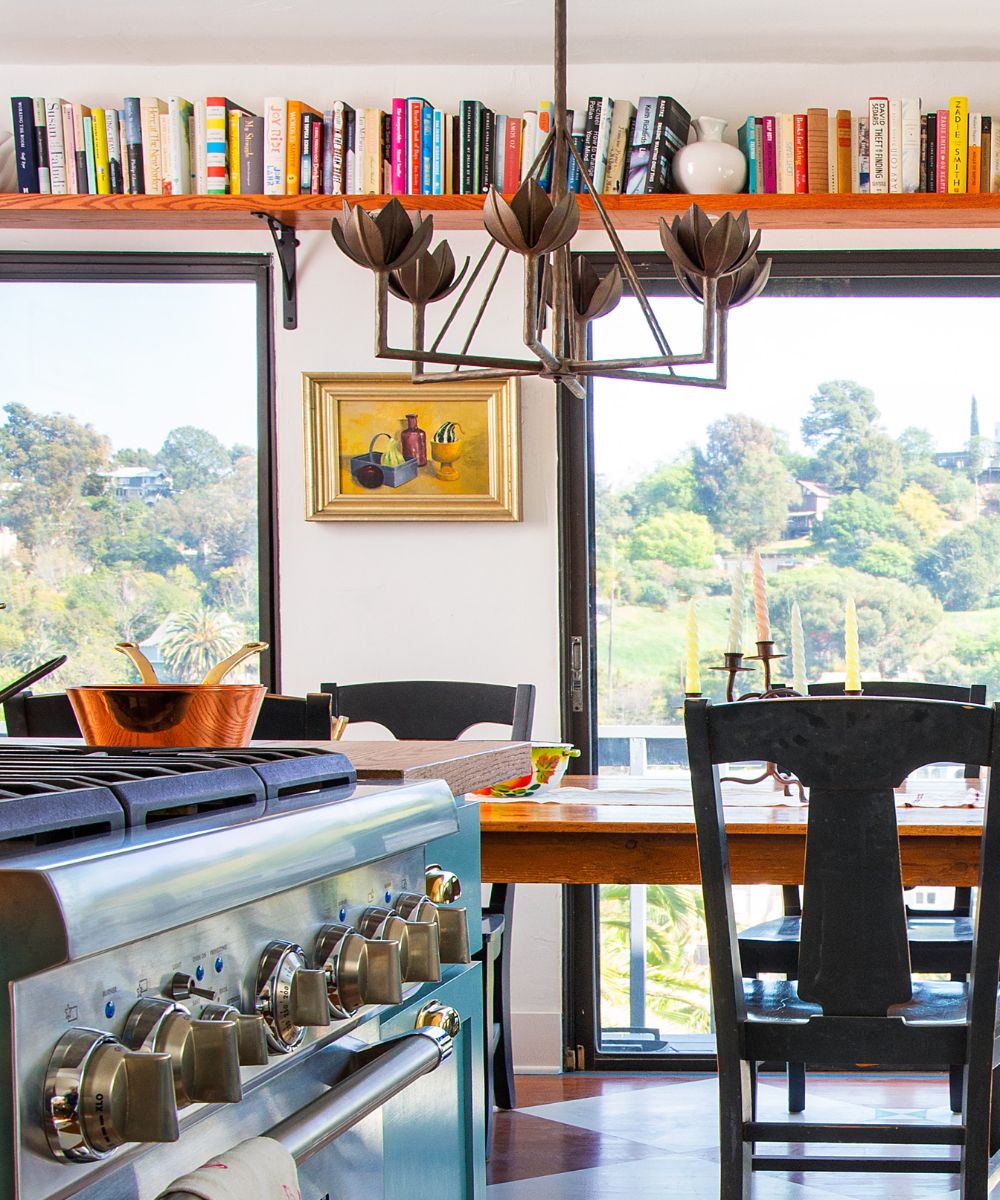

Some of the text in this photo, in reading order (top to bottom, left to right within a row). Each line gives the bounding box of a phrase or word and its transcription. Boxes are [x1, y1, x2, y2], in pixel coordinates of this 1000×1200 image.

[47, 103, 60, 138] Susan
[270, 105, 282, 125] JOY
[594, 101, 602, 126] Michael
[640, 104, 652, 144] Keith Richards
[151, 135, 160, 148] The
[584, 100, 596, 161] Pollan Your Mind
[875, 128, 883, 148] THEFT
[510, 139, 516, 149] OZ
[592, 145, 598, 153] to
[795, 146, 804, 166] Living
[51, 151, 65, 188] Faludi
[588, 153, 597, 177] Change
[875, 153, 883, 179] FINDING
[954, 148, 962, 186] SMITH
[151, 166, 161, 192] Yorker
[96, 1093, 104, 1112] XLO
